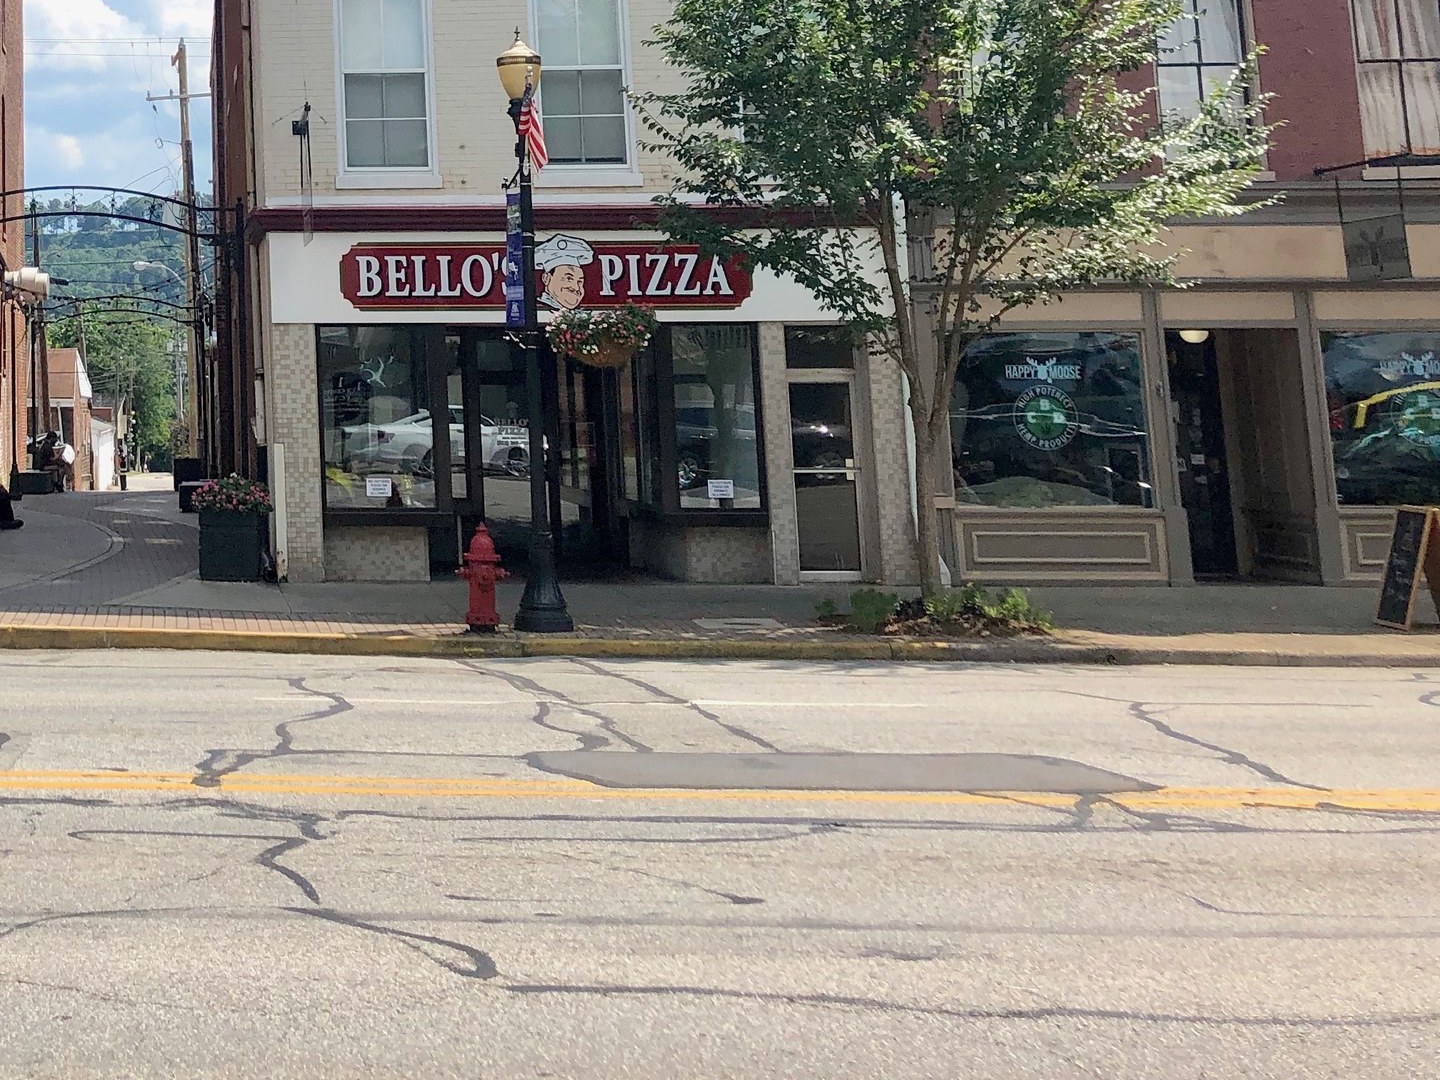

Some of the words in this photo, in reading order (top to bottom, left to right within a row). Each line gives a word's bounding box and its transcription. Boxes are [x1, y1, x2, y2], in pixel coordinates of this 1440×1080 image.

[355, 251, 507, 298] BELLO'
[597, 252, 734, 297] PIZZA
[1005, 365, 1035, 379] HAPPY
[1049, 366, 1081, 379] MOOSE
